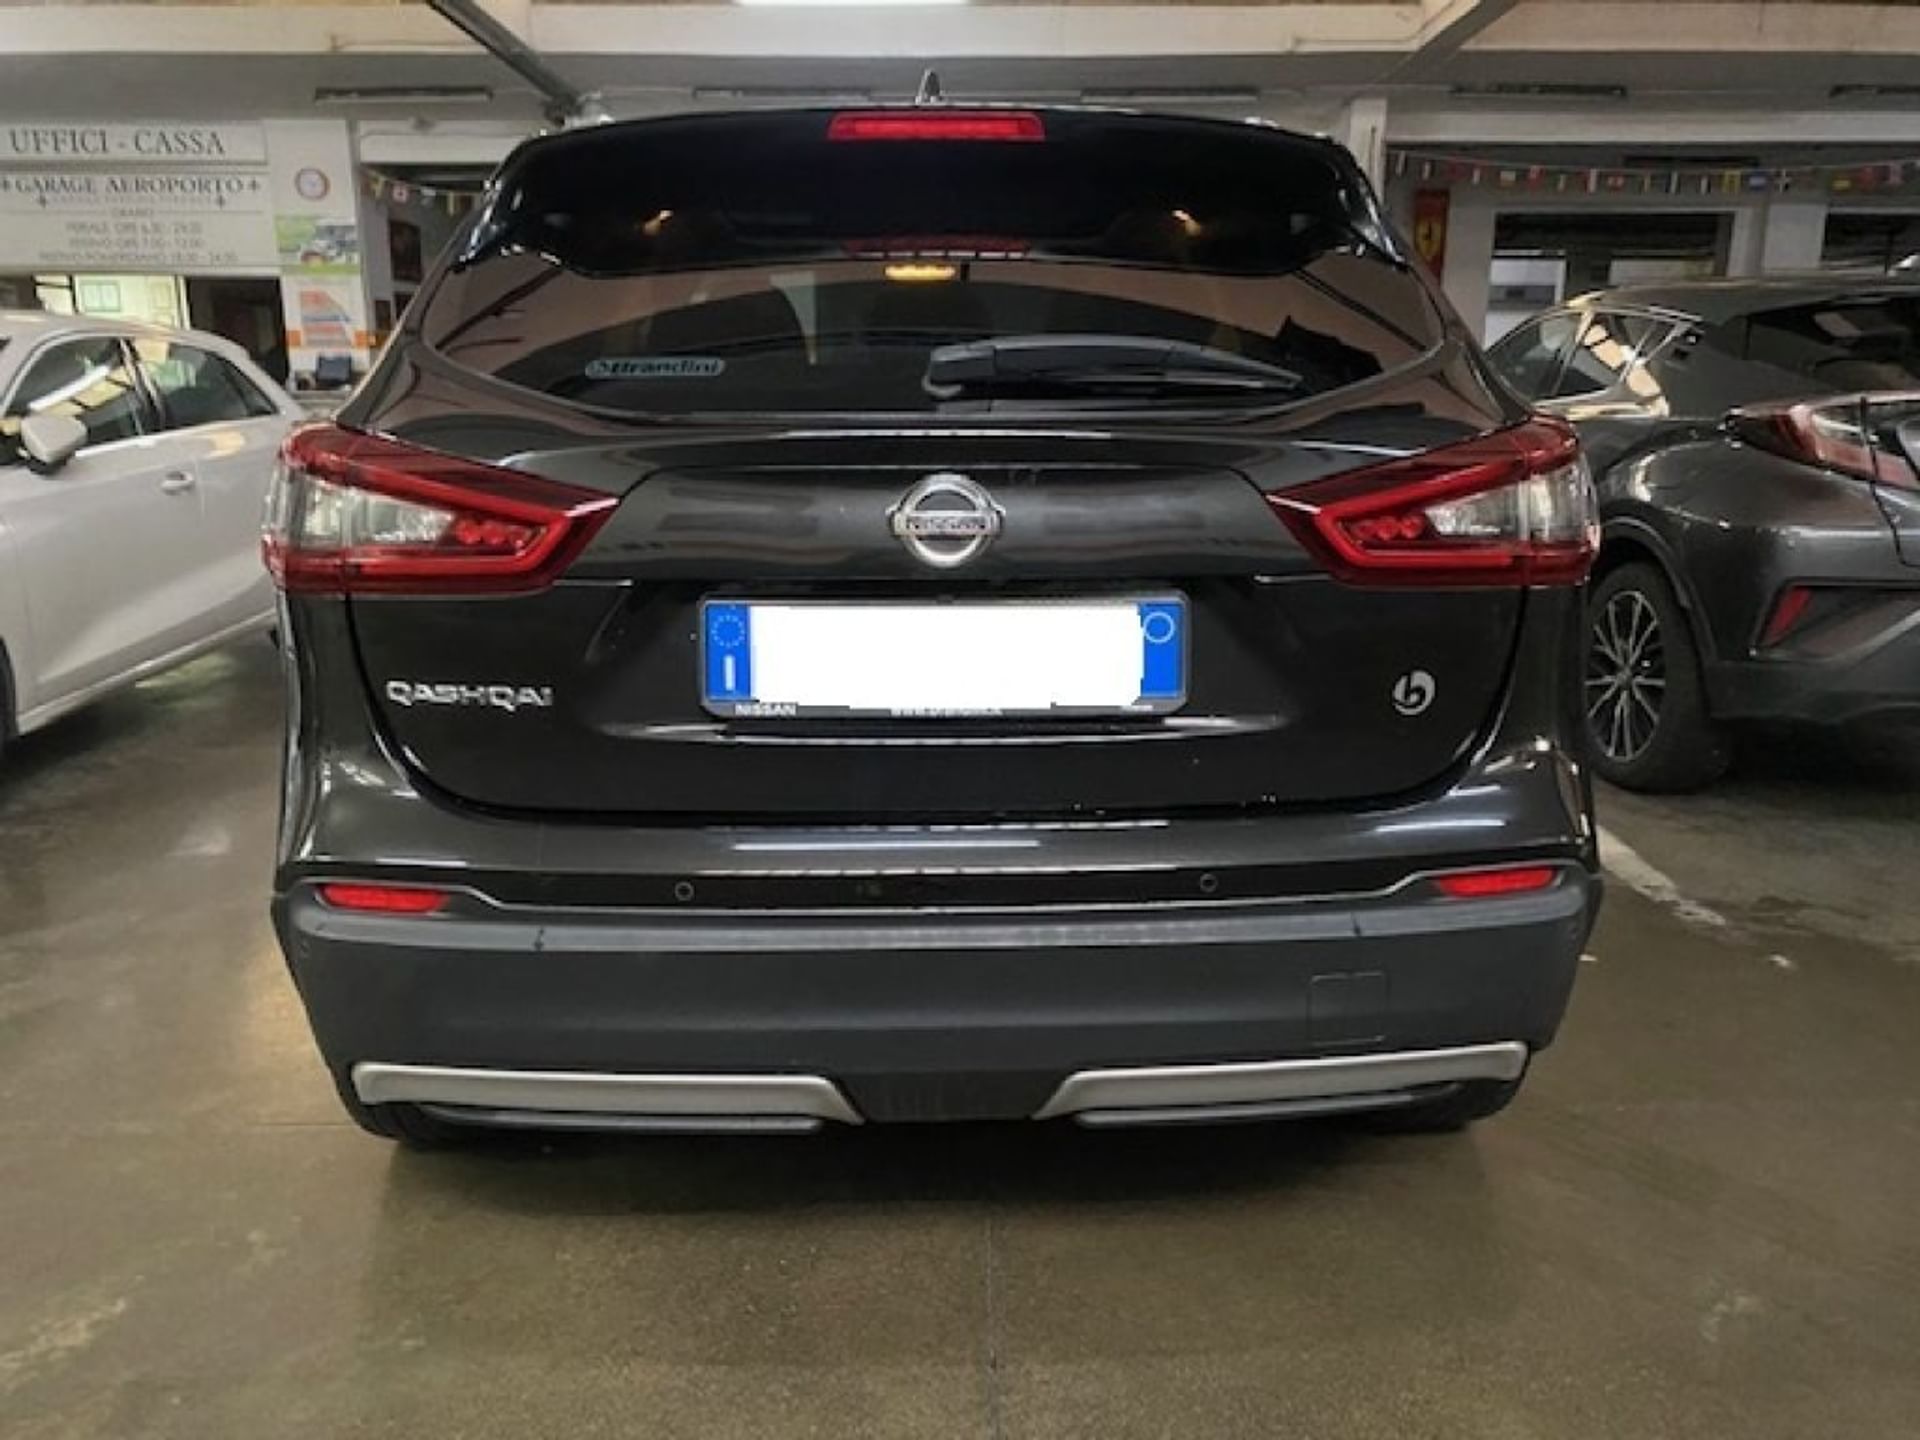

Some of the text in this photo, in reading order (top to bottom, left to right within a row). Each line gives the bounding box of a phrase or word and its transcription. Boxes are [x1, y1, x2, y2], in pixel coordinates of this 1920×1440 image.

[9, 127, 109, 154] UFFICI
[134, 128, 226, 155] CASSA
[15, 175, 244, 195] GARAGE AEROPORTO
[386, 680, 553, 712] QASHQAI
[735, 703, 797, 716] NISSAN
